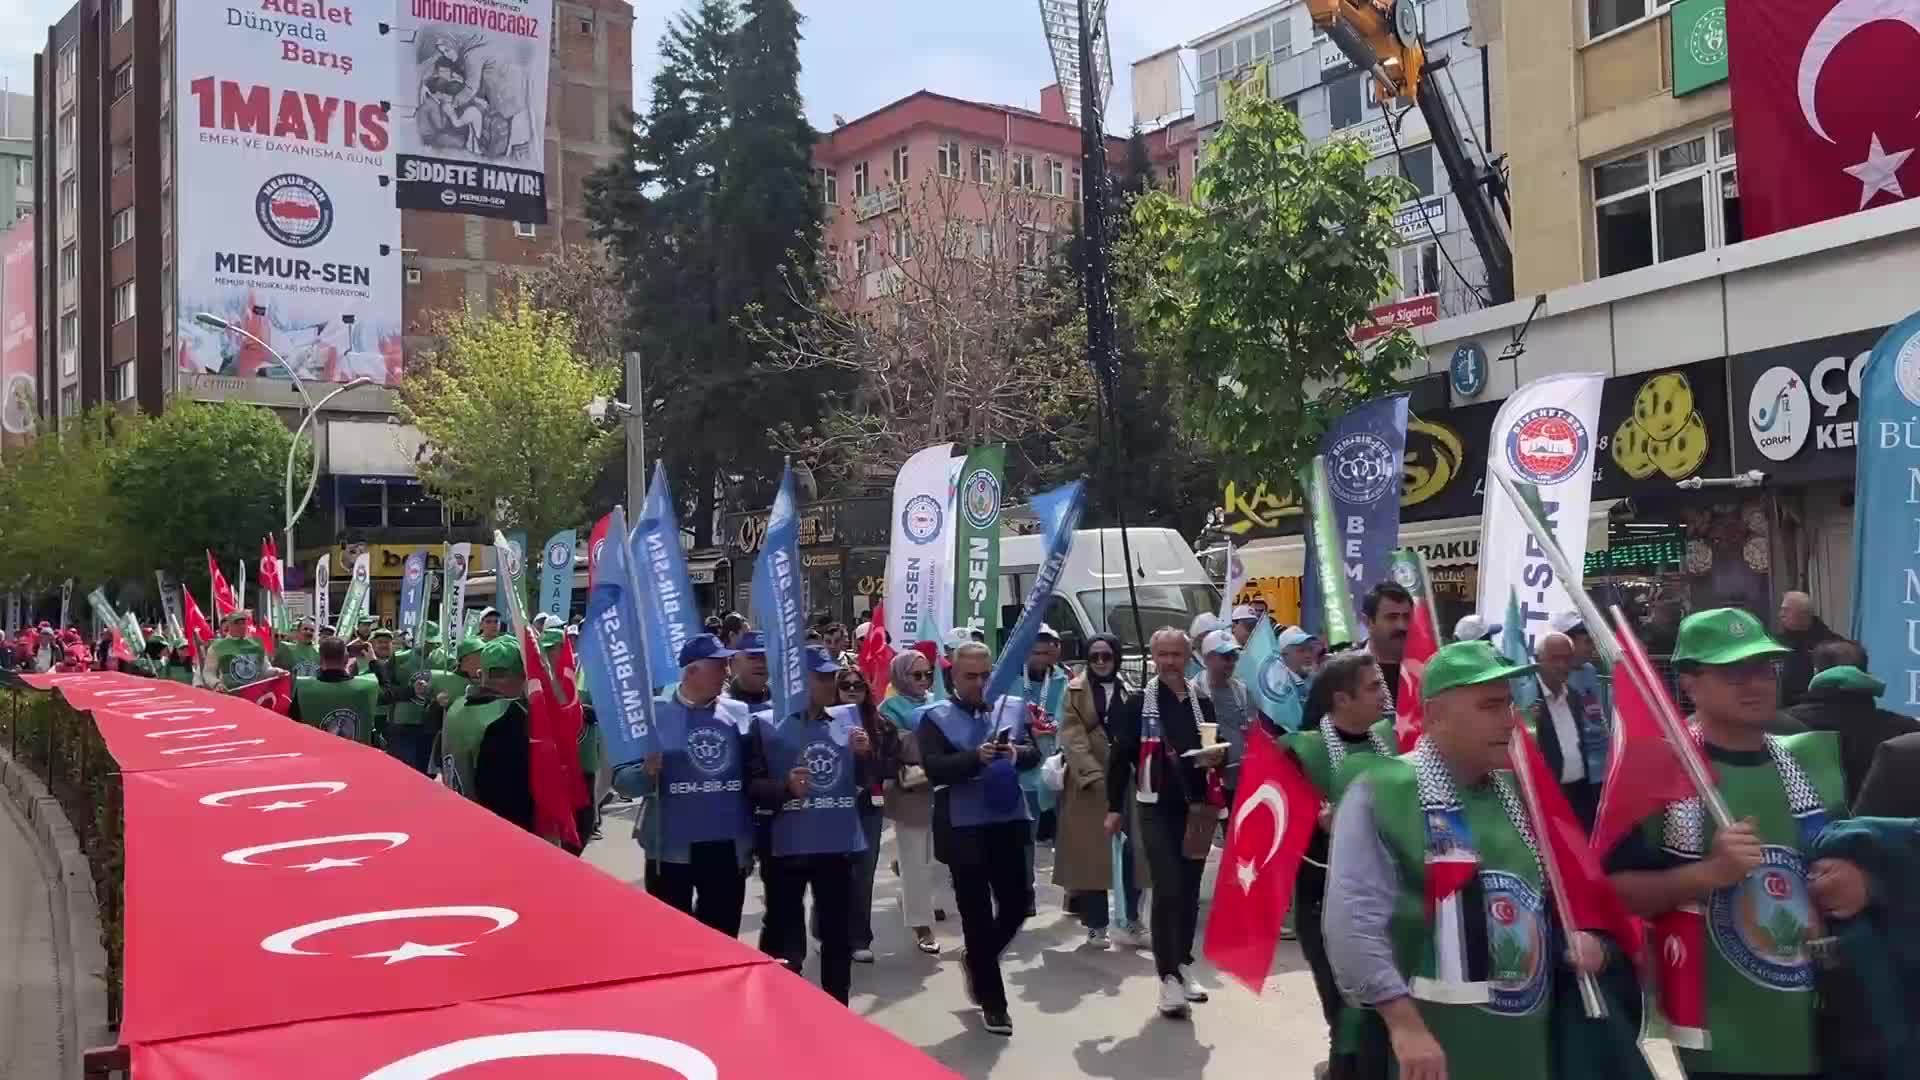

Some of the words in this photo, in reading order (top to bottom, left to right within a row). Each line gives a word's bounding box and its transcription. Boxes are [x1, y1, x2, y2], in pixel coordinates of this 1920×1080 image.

[226, 8, 328, 42] Dünyada
[281, 40, 352, 75] Barış
[200, 132, 239, 146] EMEK
[243, 138, 261, 149] VE
[215, 251, 370, 287] MEMUR-SEN
[1760, 435, 1792, 448] ÇORUM
